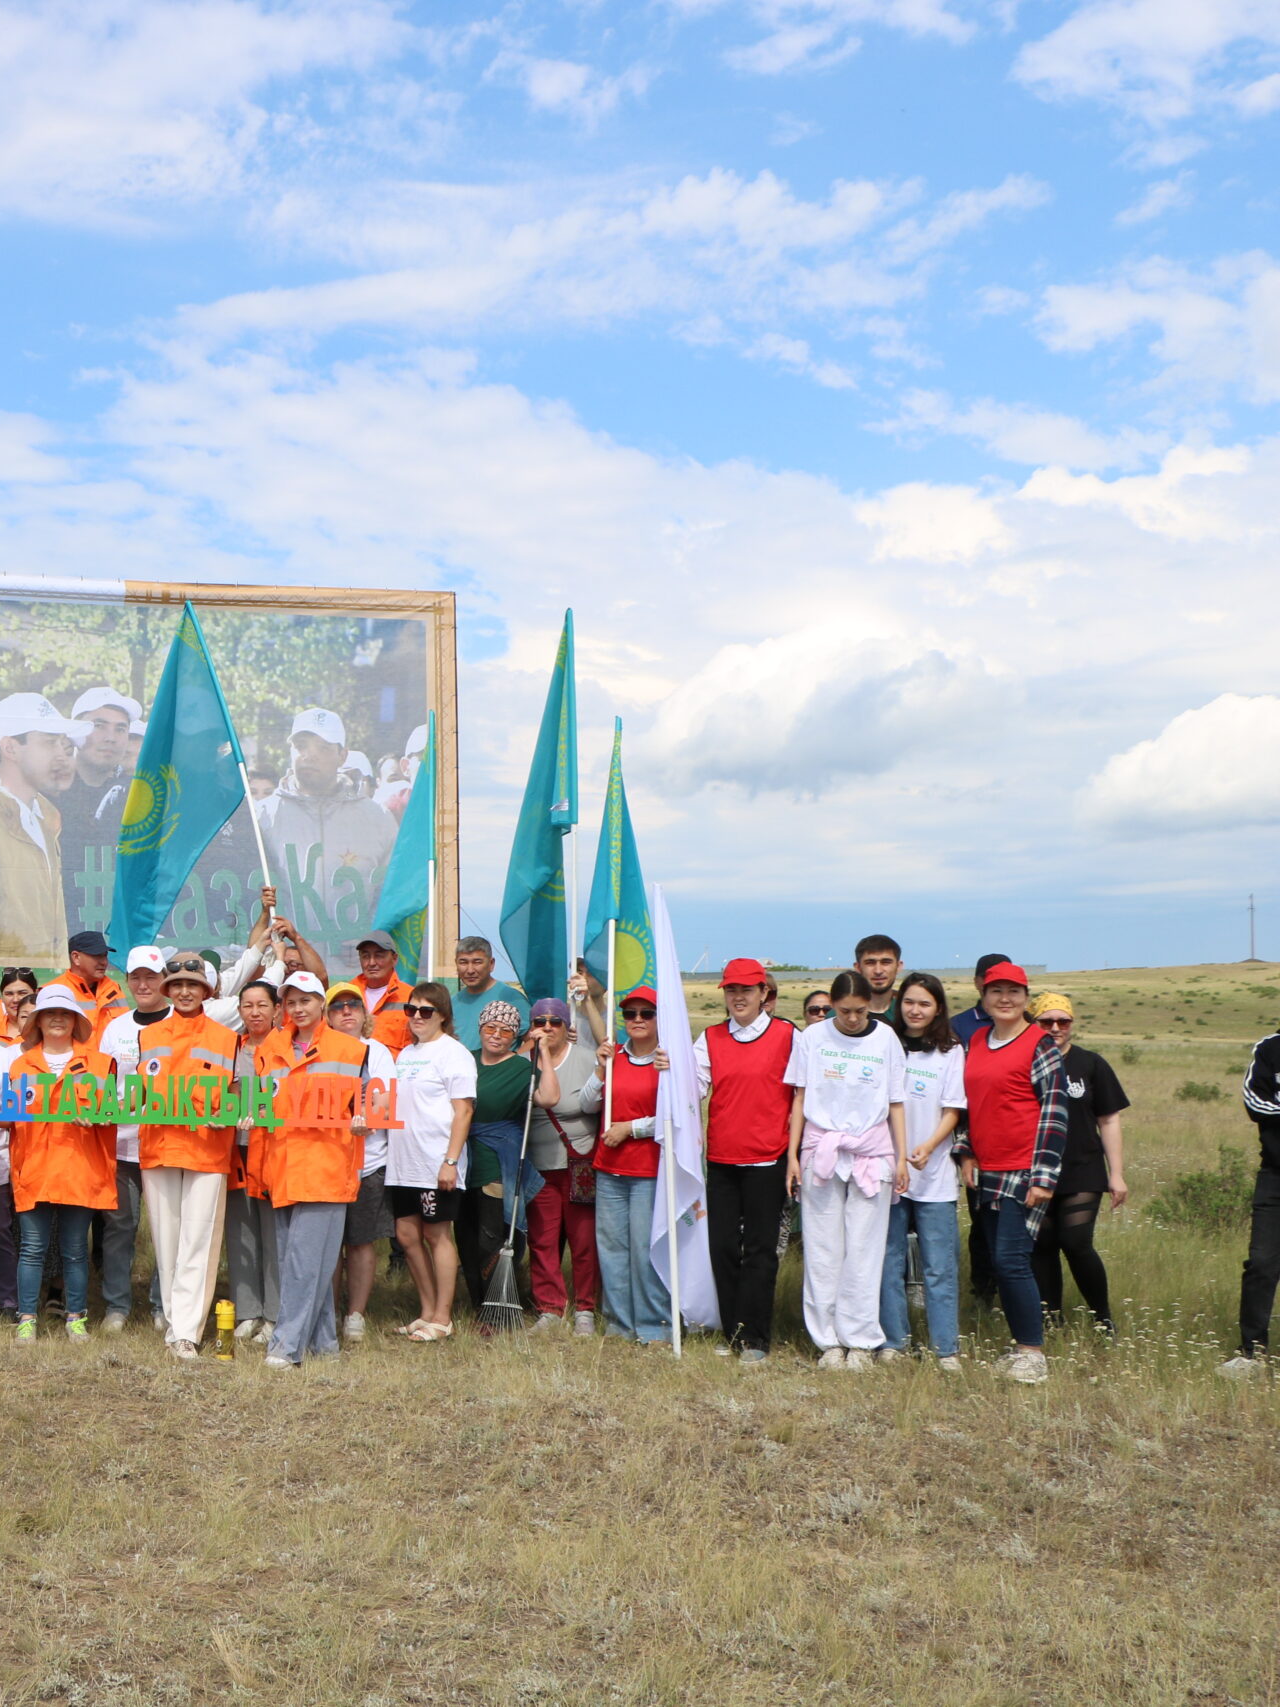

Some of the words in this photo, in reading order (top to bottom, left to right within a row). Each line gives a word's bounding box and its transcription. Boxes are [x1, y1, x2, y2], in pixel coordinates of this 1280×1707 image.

[820, 1048, 838, 1057] Taza
[840, 1050, 884, 1065] Qazaqstan
[35, 1072, 276, 1132] ТАЗАЛЫҚТЫҢ
